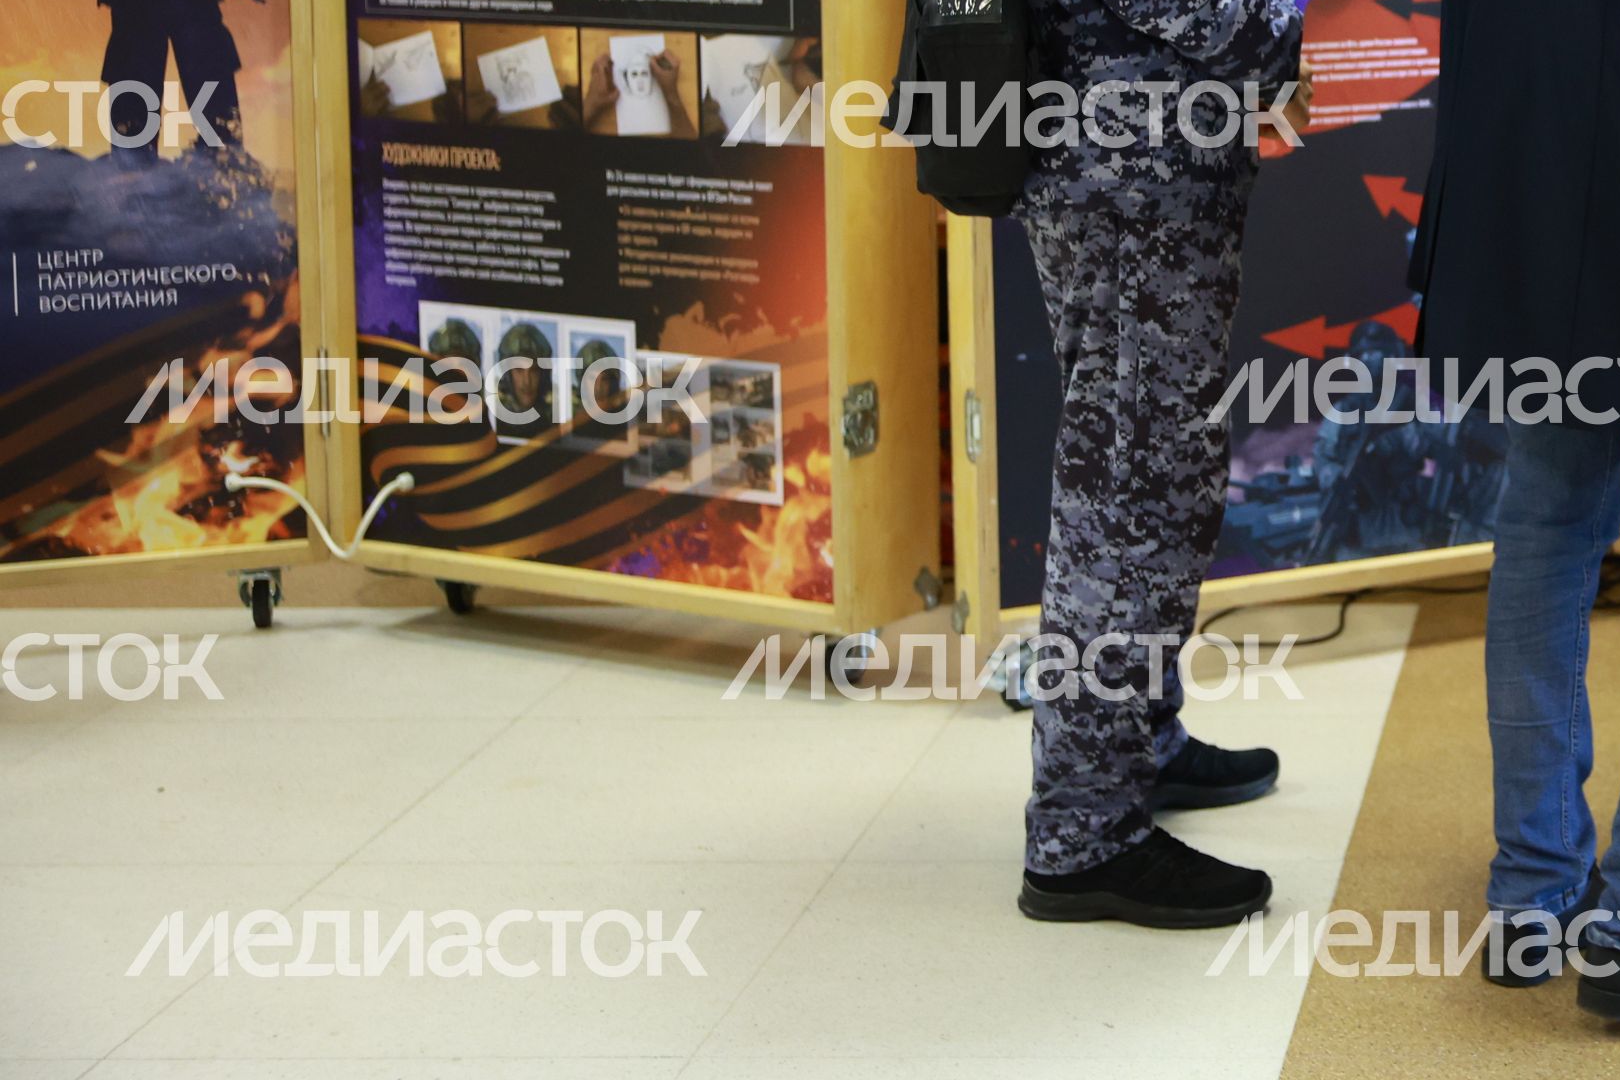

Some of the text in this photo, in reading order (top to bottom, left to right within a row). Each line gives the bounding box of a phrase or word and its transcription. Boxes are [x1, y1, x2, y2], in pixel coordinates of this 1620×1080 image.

[38, 249, 103, 271] ЦЕНТР
[38, 263, 236, 291] ПАТРИОТИЧЕСКОГО
[39, 288, 178, 313] ВОСПИТАНИЯ
